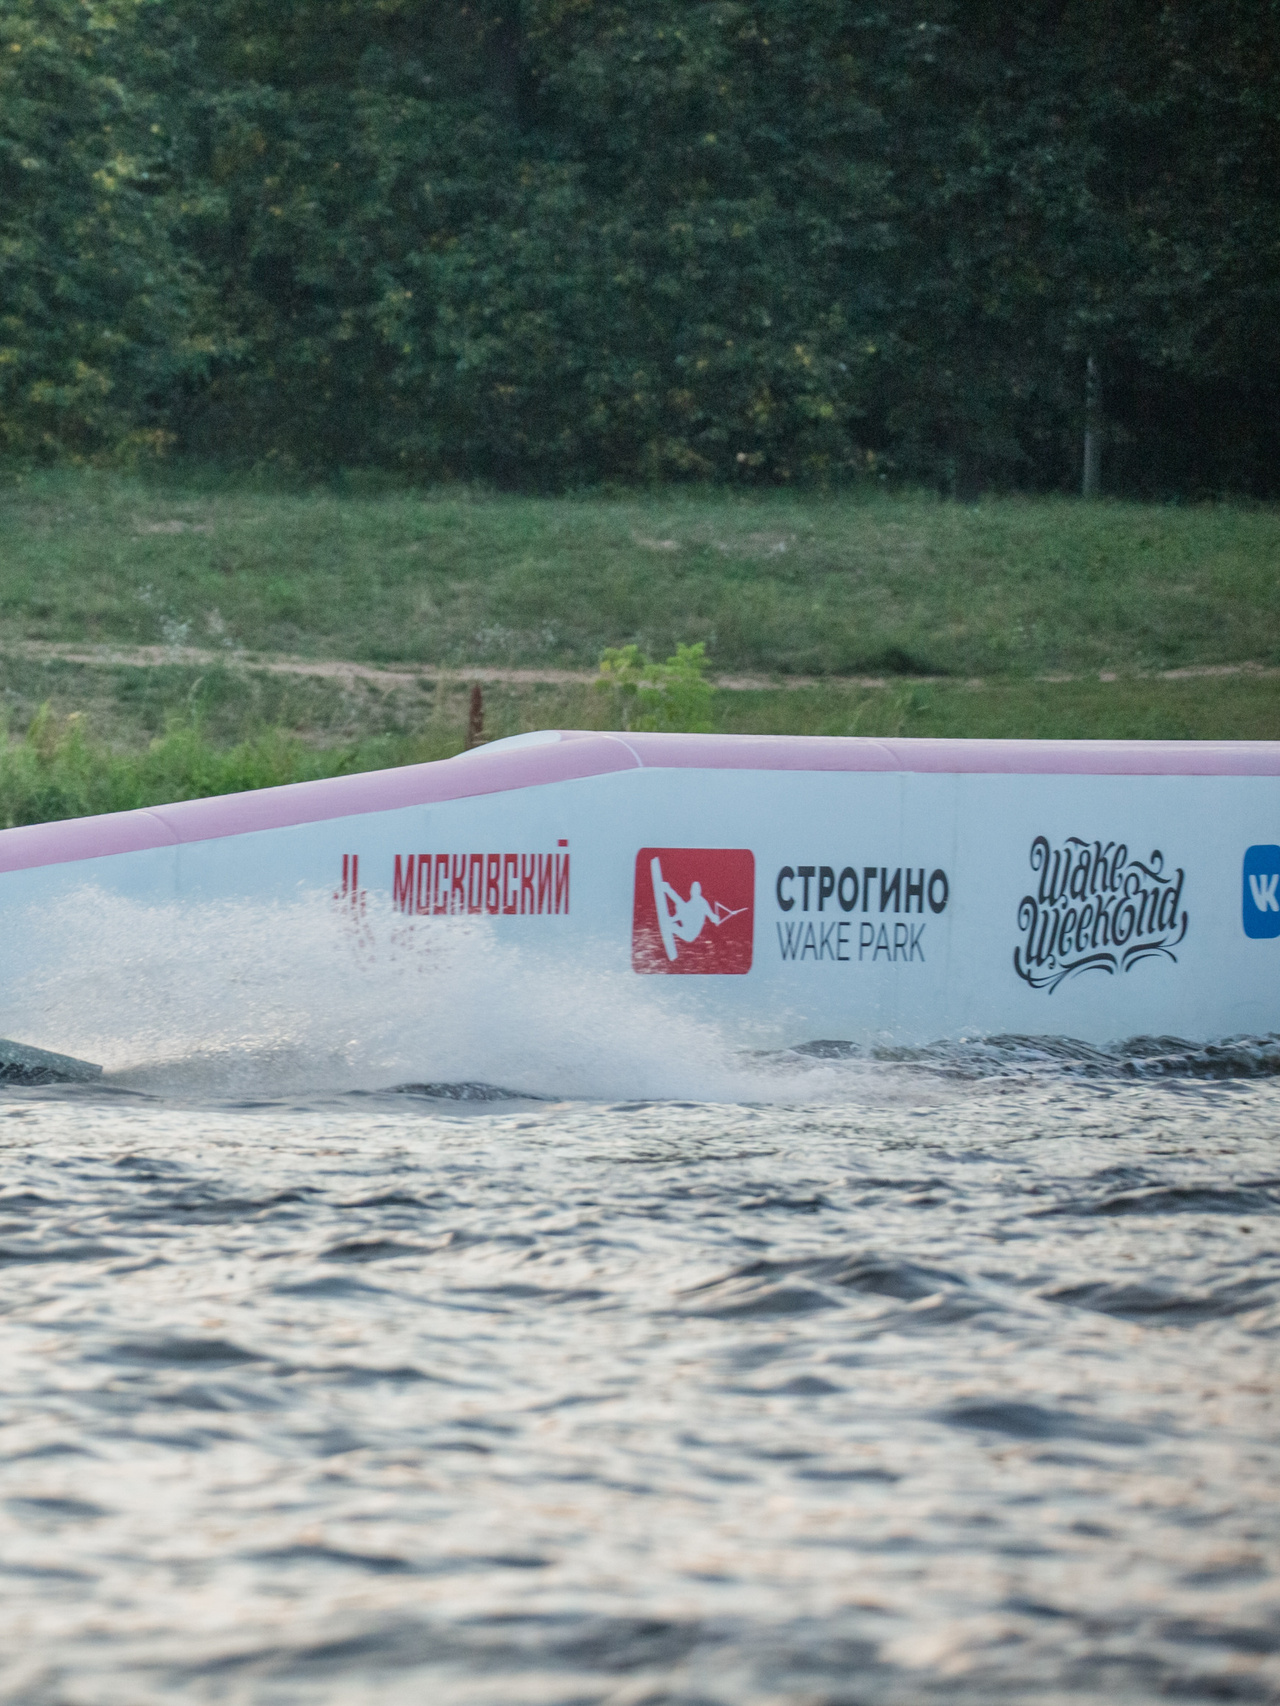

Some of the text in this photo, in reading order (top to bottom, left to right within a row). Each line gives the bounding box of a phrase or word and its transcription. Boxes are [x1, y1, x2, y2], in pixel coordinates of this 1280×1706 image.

[393, 839, 570, 915] МОСКОВСКИЙ
[776, 865, 949, 914] СТРОГИНО
[776, 921, 926, 962] WAKE PARK
